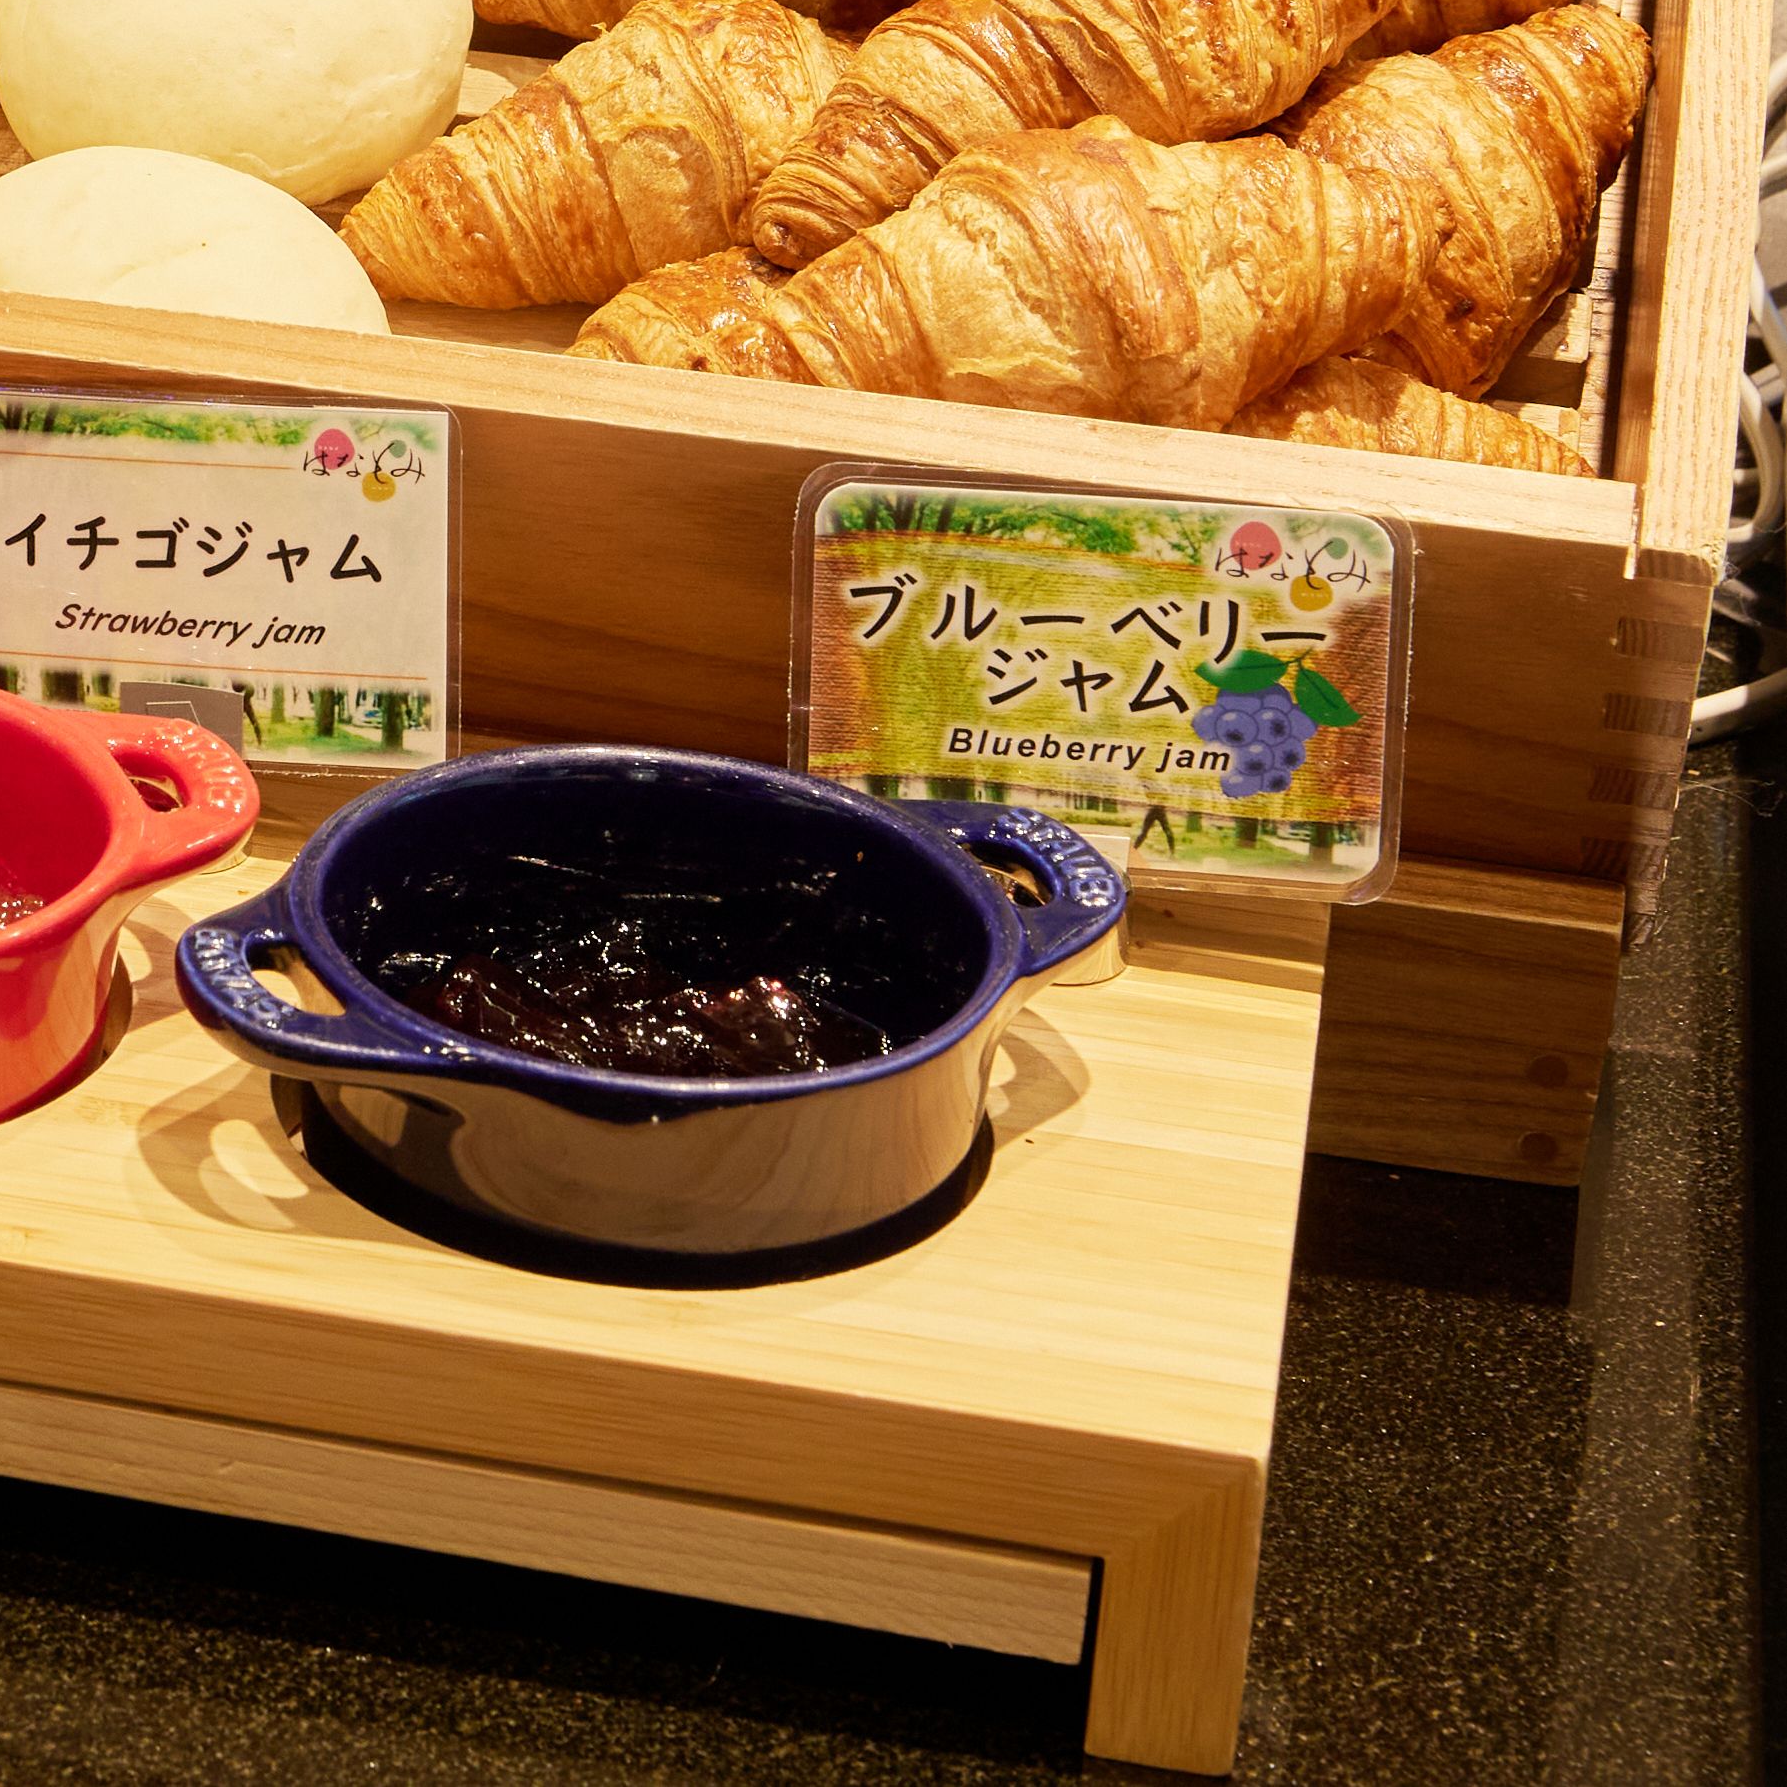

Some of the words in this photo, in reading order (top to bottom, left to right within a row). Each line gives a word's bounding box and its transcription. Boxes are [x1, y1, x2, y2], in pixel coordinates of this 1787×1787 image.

[4, 512, 383, 584] イチゴジャム
[55, 603, 253, 648] Strawberry
[252, 615, 327, 650] jam
[849, 572, 1328, 665] ブルーベリー
[986, 646, 1190, 714] ジャム
[948, 727, 1146, 773] Blueberry
[1154, 742, 1231, 774] jam
